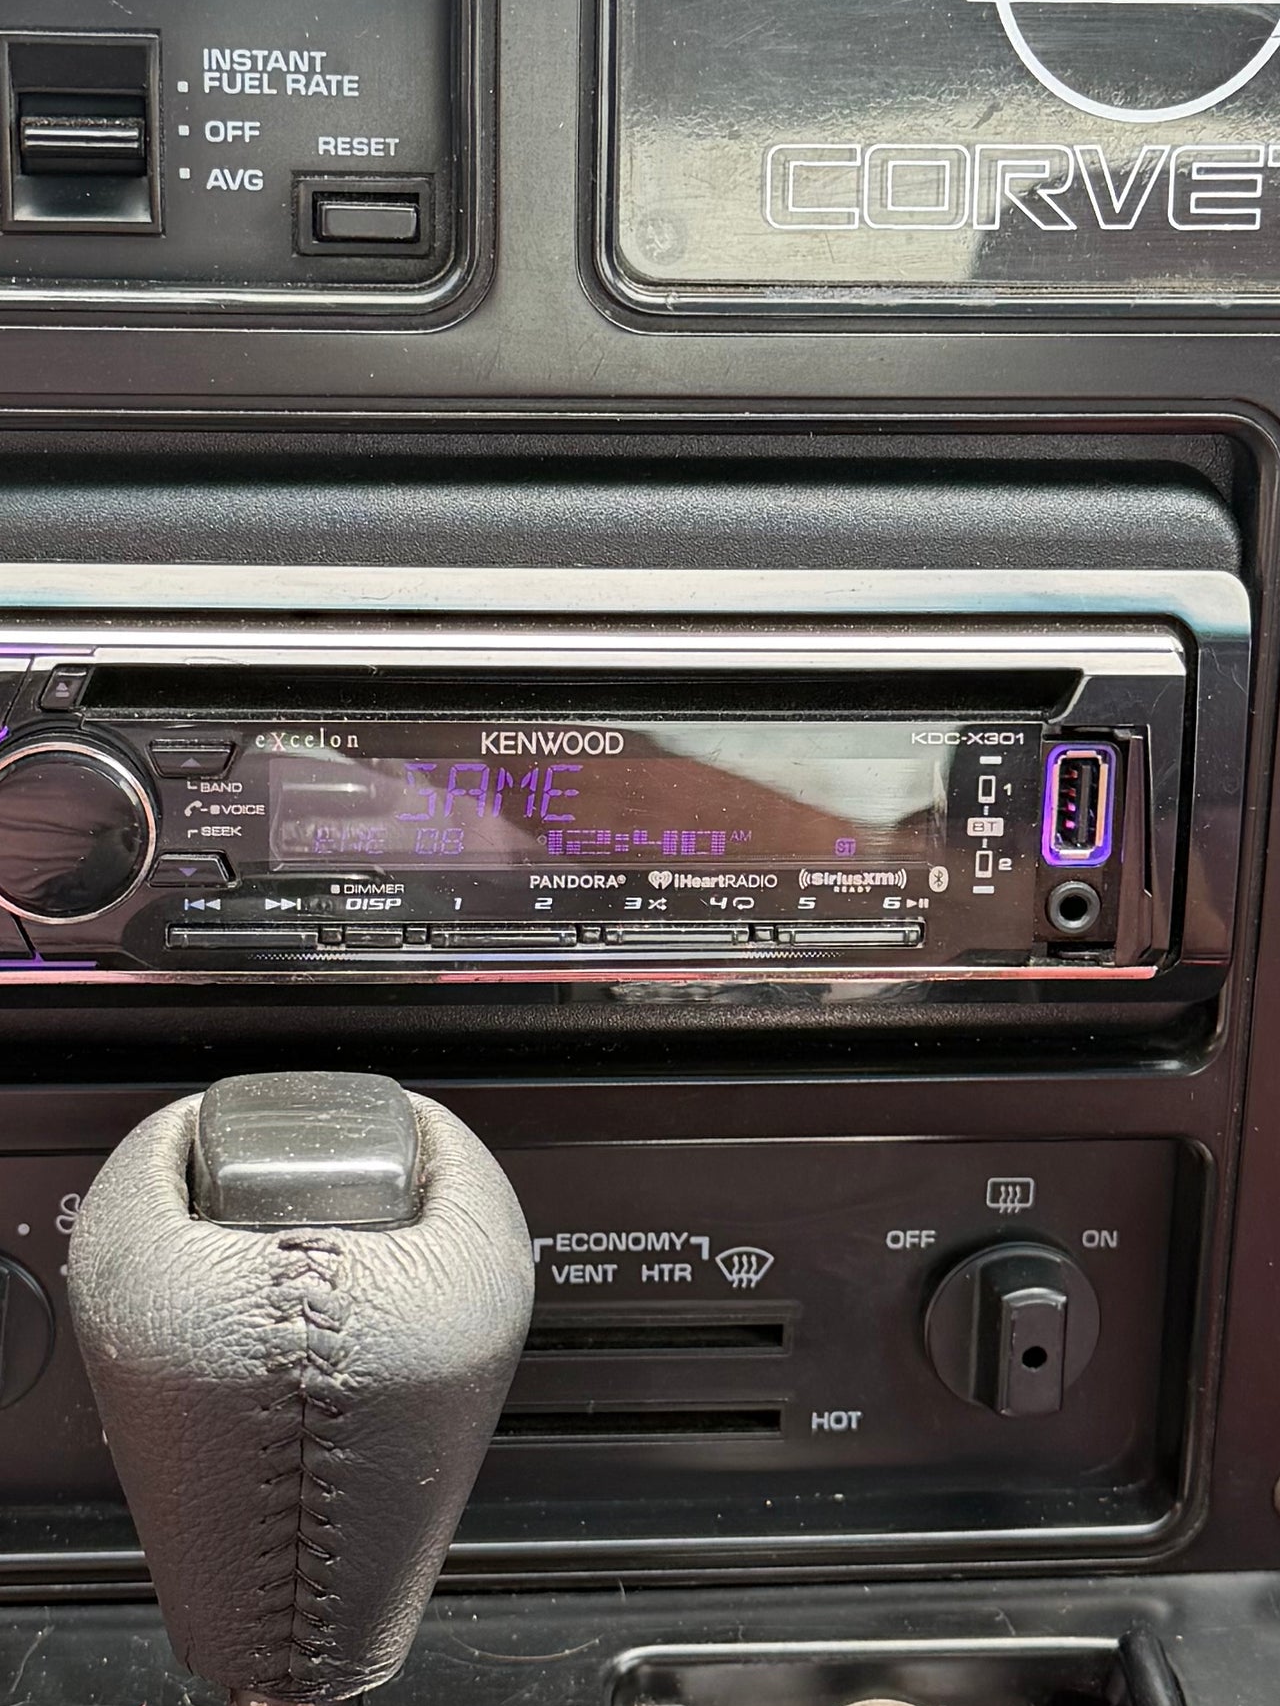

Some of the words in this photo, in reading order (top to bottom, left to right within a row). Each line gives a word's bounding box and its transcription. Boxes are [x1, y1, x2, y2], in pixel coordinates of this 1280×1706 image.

[203, 48, 326, 72] INSTANT
[204, 73, 278, 95] FUEL
[288, 74, 359, 97] RATE
[205, 120, 260, 143] OFF
[319, 136, 398, 157] RESET
[206, 168, 263, 191] AVG
[481, 731, 624, 756] KENWOOD
[911, 732, 1025, 745] KDC-X301
[200, 782, 242, 793] BAND
[1003, 783, 1012, 796] 1
[222, 804, 265, 815] VOICE
[201, 826, 242, 836] SEEK
[973, 822, 996, 832] BT
[547, 829, 725, 855] 12:40
[731, 831, 752, 842] AM
[837, 841, 854, 852] ST
[998, 858, 1012, 870] 2
[344, 884, 404, 894] DIMMER
[345, 898, 402, 910] DISP
[454, 898, 463, 910] 1
[534, 898, 552, 910] 2
[624, 897, 642, 910] 3
[710, 897, 728, 910] 4
[798, 897, 816, 910] 5
[883, 897, 901, 910] 6
[556, 1233, 690, 1252] ECONOMY
[886, 1230, 936, 1250] OFF
[1082, 1230, 1118, 1250] ON
[551, 1264, 618, 1285] VENT
[641, 1264, 693, 1284] HTR
[812, 1411, 861, 1432] HOT
